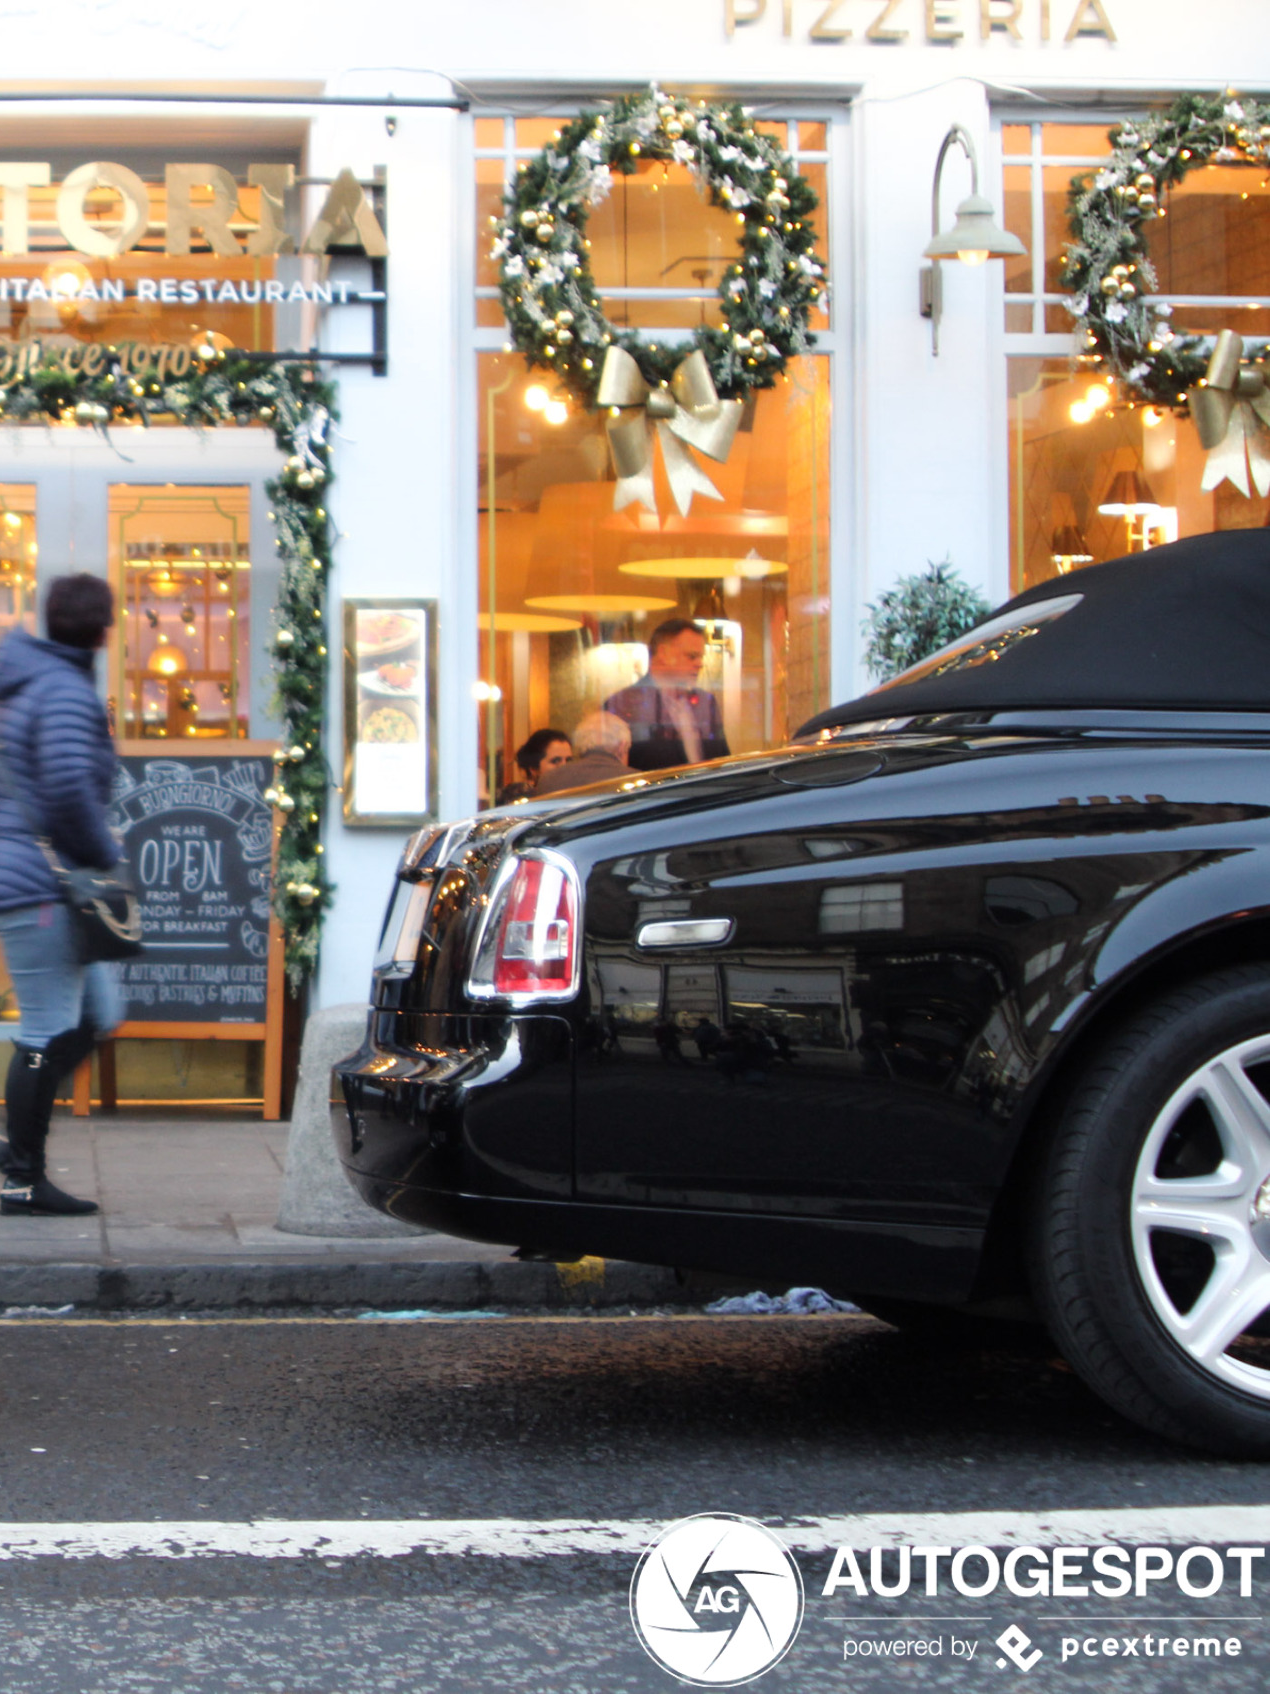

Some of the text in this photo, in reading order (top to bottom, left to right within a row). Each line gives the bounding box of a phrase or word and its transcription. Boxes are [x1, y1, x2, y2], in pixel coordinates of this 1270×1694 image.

[723, 0, 1118, 44] PIZZERIA
[0, 277, 125, 303] ITALIAN
[136, 277, 353, 304] RESTAURANT
[117, 343, 191, 383] 1970
[161, 825, 206, 837] WE ARE
[139, 839, 223, 893] OPEN
[146, 890, 180, 902] FROM
[132, 904, 181, 918] ONDAY
[197, 904, 246, 918] FRIDAY
[163, 920, 228, 933] BREAKFAST
